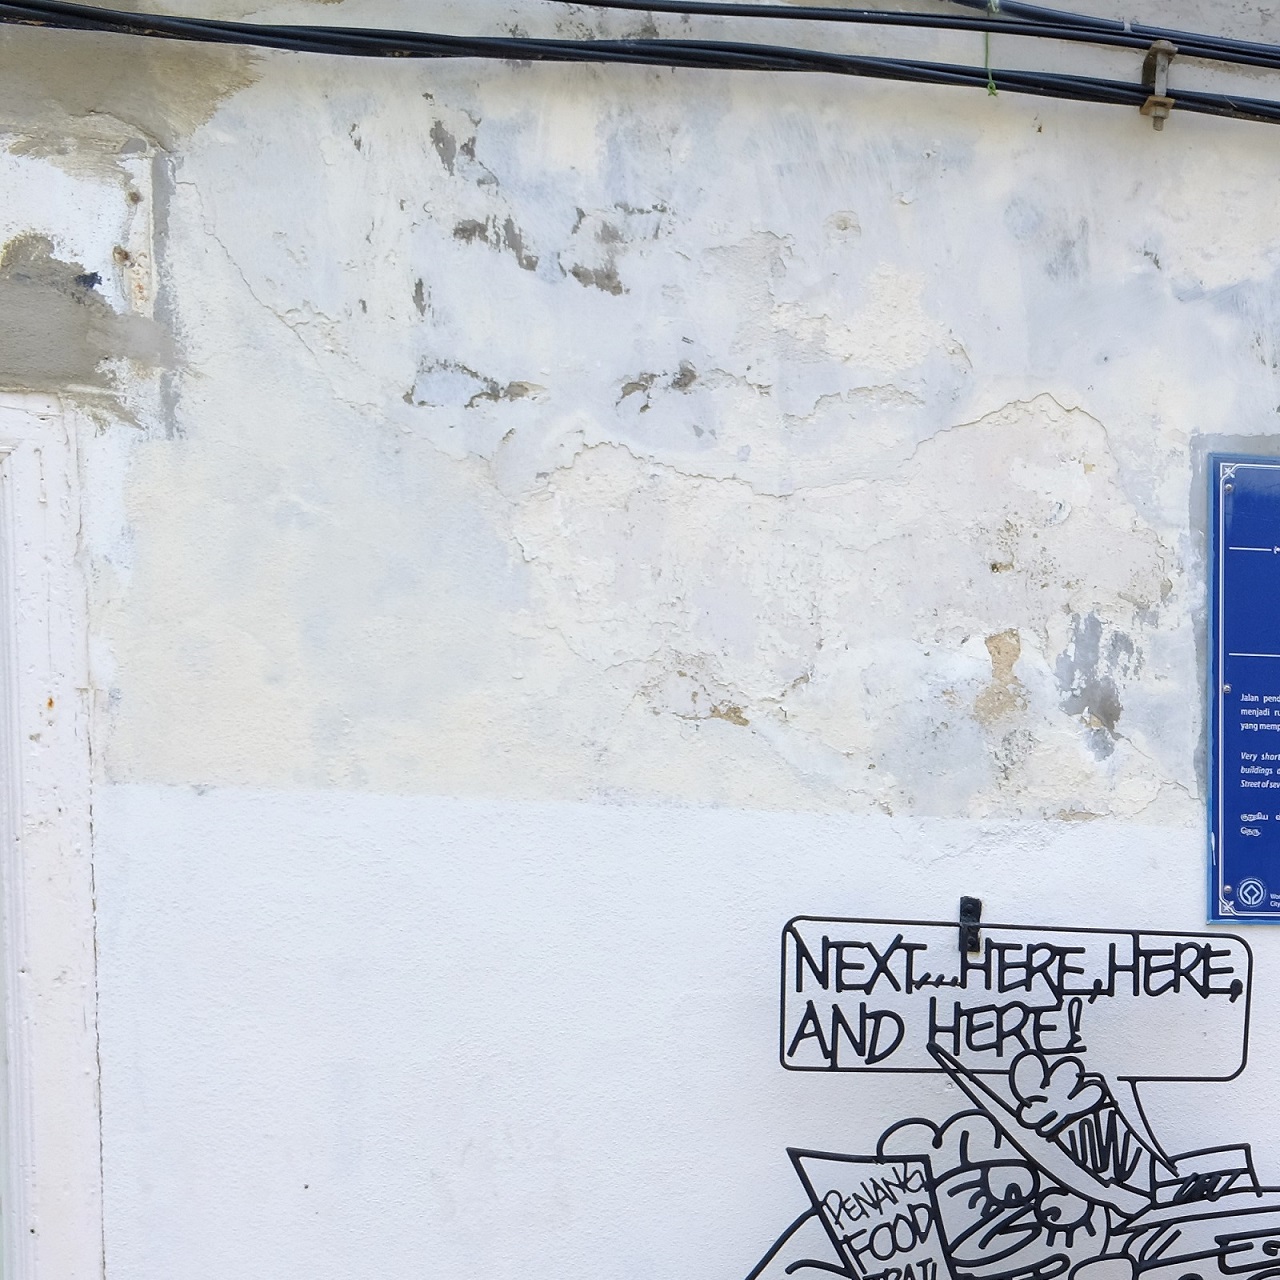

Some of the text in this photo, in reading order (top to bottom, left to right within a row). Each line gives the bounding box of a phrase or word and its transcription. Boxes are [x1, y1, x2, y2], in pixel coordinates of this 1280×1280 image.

[1240, 694, 1259, 702] Jalan
[1241, 708, 1270, 717] menjadi
[1240, 723, 1258, 731] yang
[1240, 752, 1257, 761] Very
[1261, 752, 1280, 761] short
[1241, 766, 1273, 776] buildings
[1240, 780, 1260, 788] Street
[1261, 780, 1269, 788] of
[787, 996, 1087, 1065] AND HERE!
[824, 1166, 930, 1230] PENANG
[843, 1203, 933, 1275] FOOD
